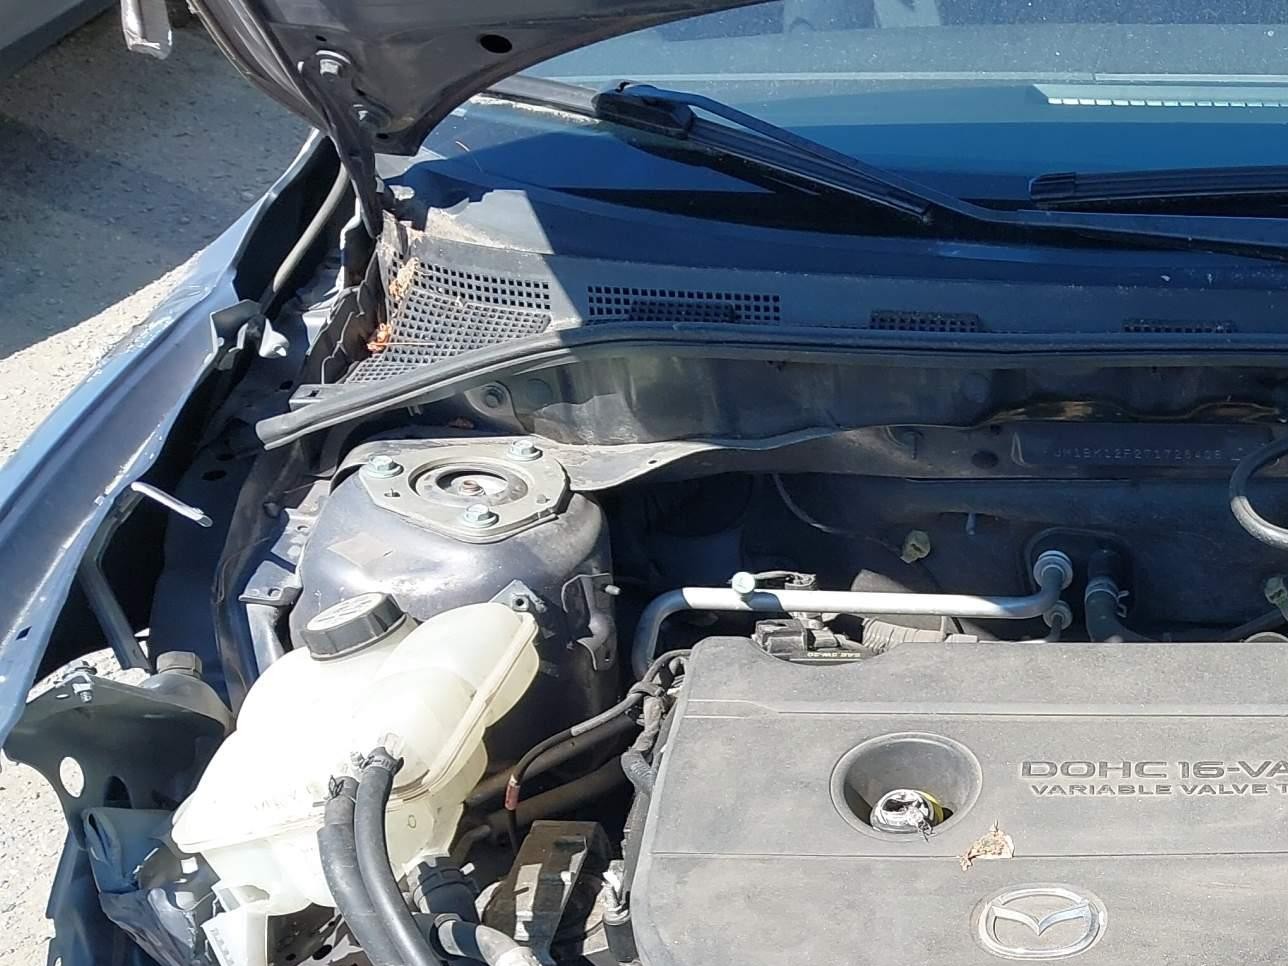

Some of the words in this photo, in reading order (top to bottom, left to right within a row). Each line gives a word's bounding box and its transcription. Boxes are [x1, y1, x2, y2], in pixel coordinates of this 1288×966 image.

[1021, 760, 1168, 779] DOHC
[1031, 784, 1172, 796] VARIABLE
[1180, 783, 1268, 795] VALVE
